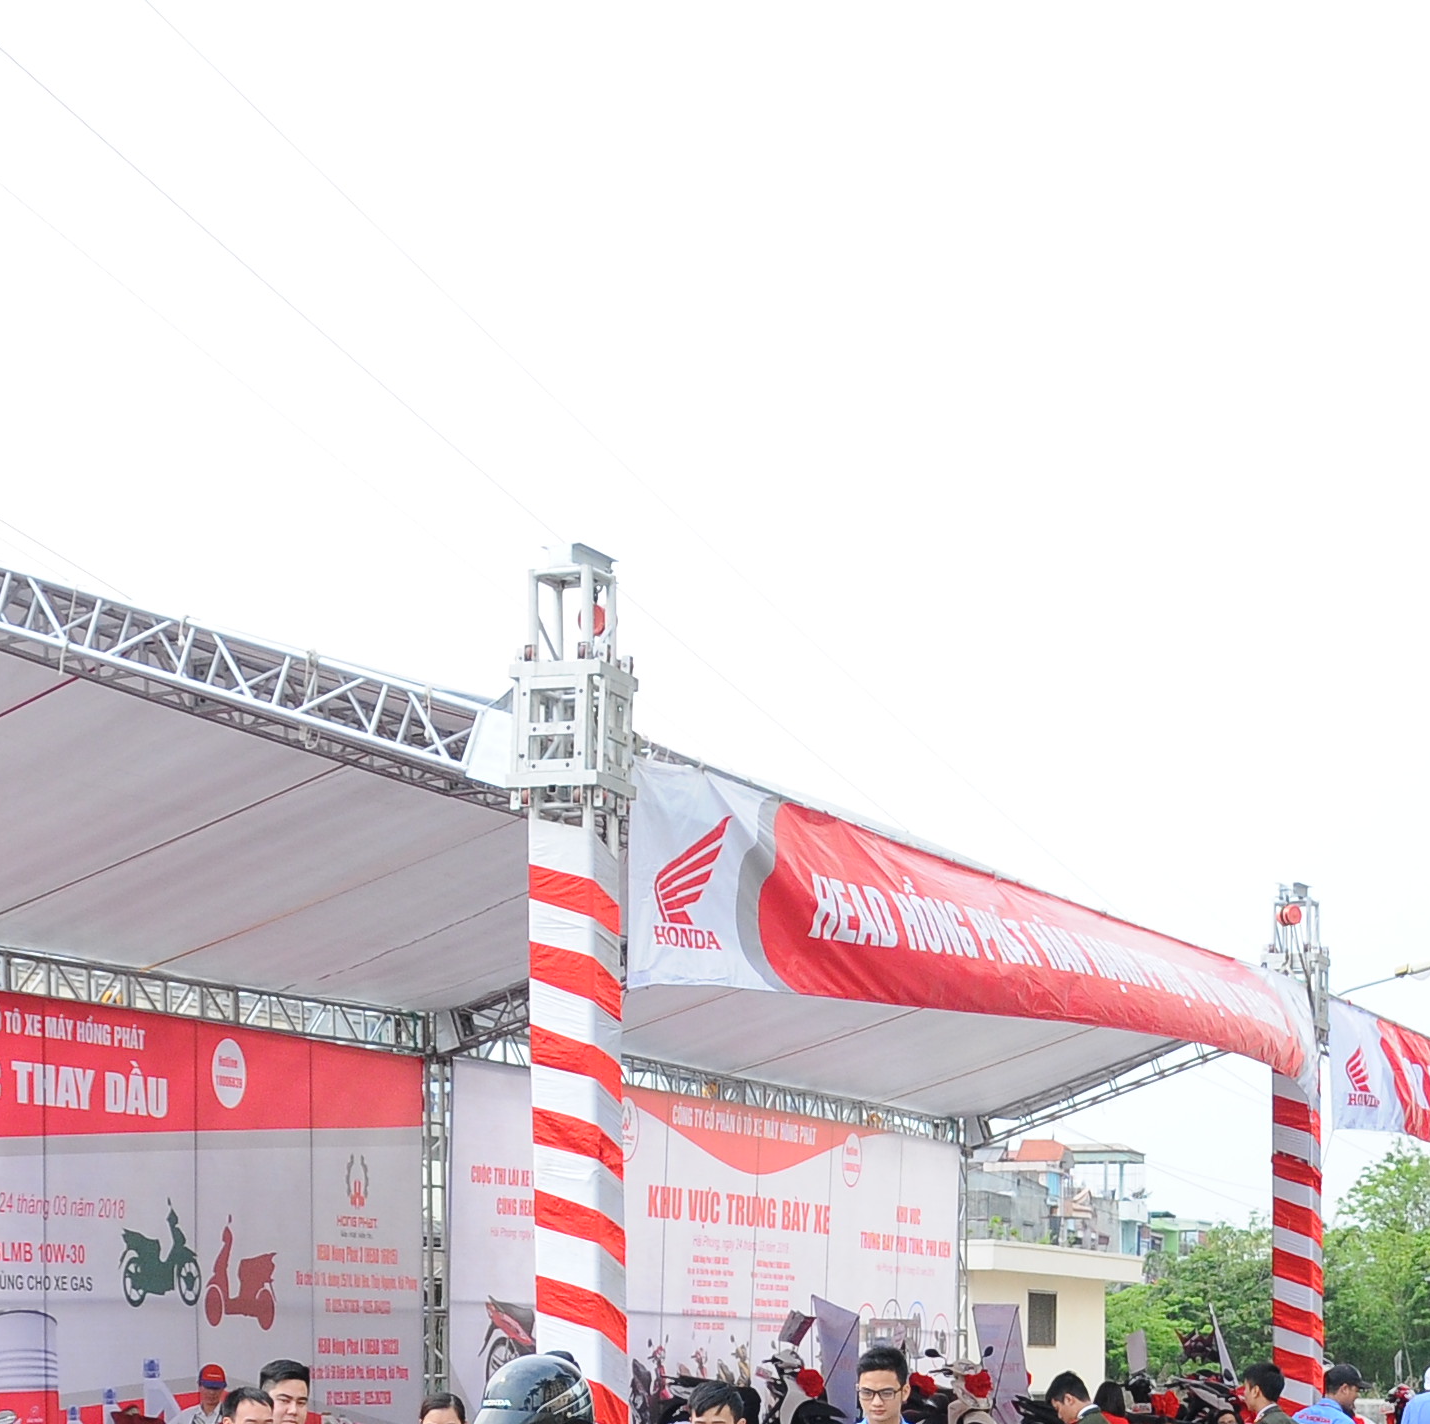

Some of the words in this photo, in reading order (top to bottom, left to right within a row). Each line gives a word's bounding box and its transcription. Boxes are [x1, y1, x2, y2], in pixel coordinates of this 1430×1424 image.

[807, 873, 898, 948] HEAD
[889, 876, 979, 959] HỒNG
[963, 905, 1043, 967] PHÁT
[653, 925, 722, 951] HONDA
[4, 1008, 22, 1035] TÔ
[24, 1013, 42, 1037] XE
[44, 1014, 74, 1040] MÁY
[76, 1016, 111, 1047] HỒNG
[114, 1024, 146, 1050] PHÁT
[11, 1061, 95, 1111] THAY
[104, 1061, 169, 1119] DẦU
[694, 1107, 703, 1127] TY
[753, 1117, 762, 1137] XE
[17, 1194, 49, 1220] tháng
[53, 1196, 67, 1216] 03
[71, 1198, 95, 1217] năm
[98, 1199, 125, 1219] 2018
[647, 1184, 683, 1220] KHU
[688, 1186, 721, 1229] VỰC
[782, 1196, 810, 1232] BÀY
[814, 1204, 831, 1235] XE
[38, 1244, 85, 1264] 10W-30
[27, 1275, 51, 1291] CHO
[53, 1276, 67, 1291] XE
[71, 1276, 93, 1292] GAS
